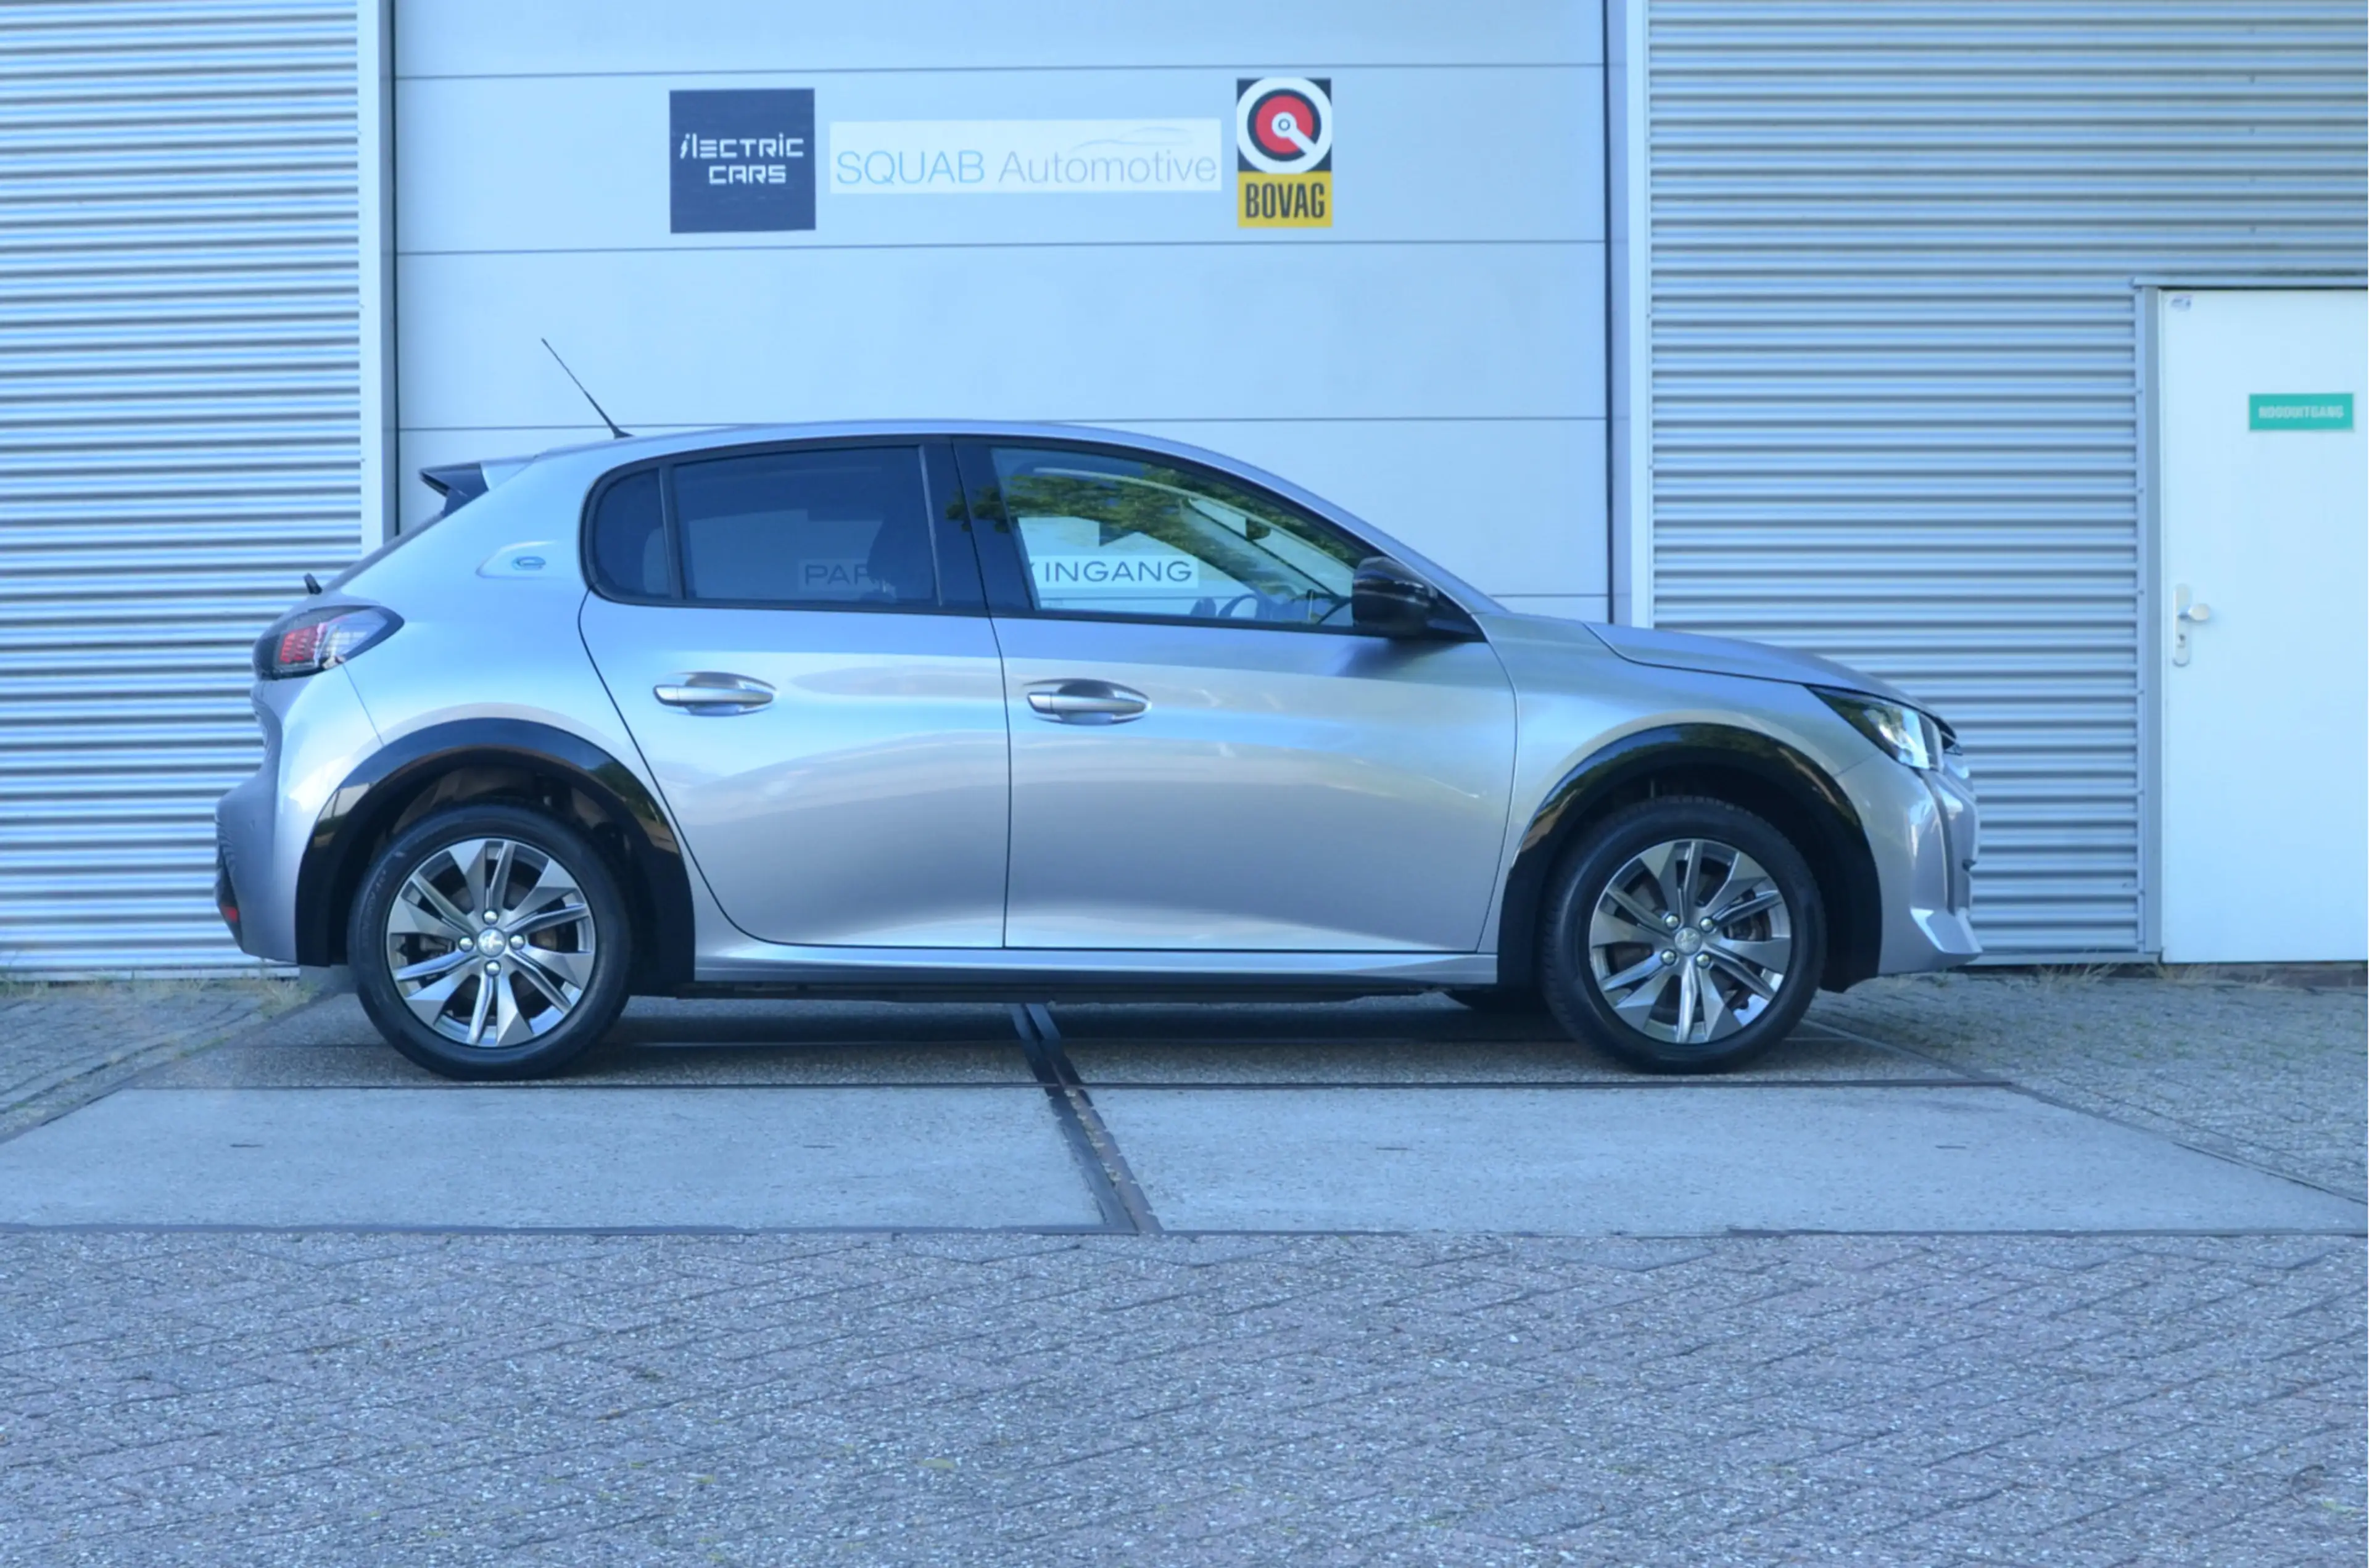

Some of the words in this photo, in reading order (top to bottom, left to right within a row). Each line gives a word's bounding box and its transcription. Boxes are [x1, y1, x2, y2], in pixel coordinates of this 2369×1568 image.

[709, 164, 786, 185] CARS
[837, 149, 985, 184] SQUAB
[998, 150, 1217, 184] Automotive
[1245, 181, 1325, 218] BOVAG
[1045, 560, 1193, 582] INGANG
